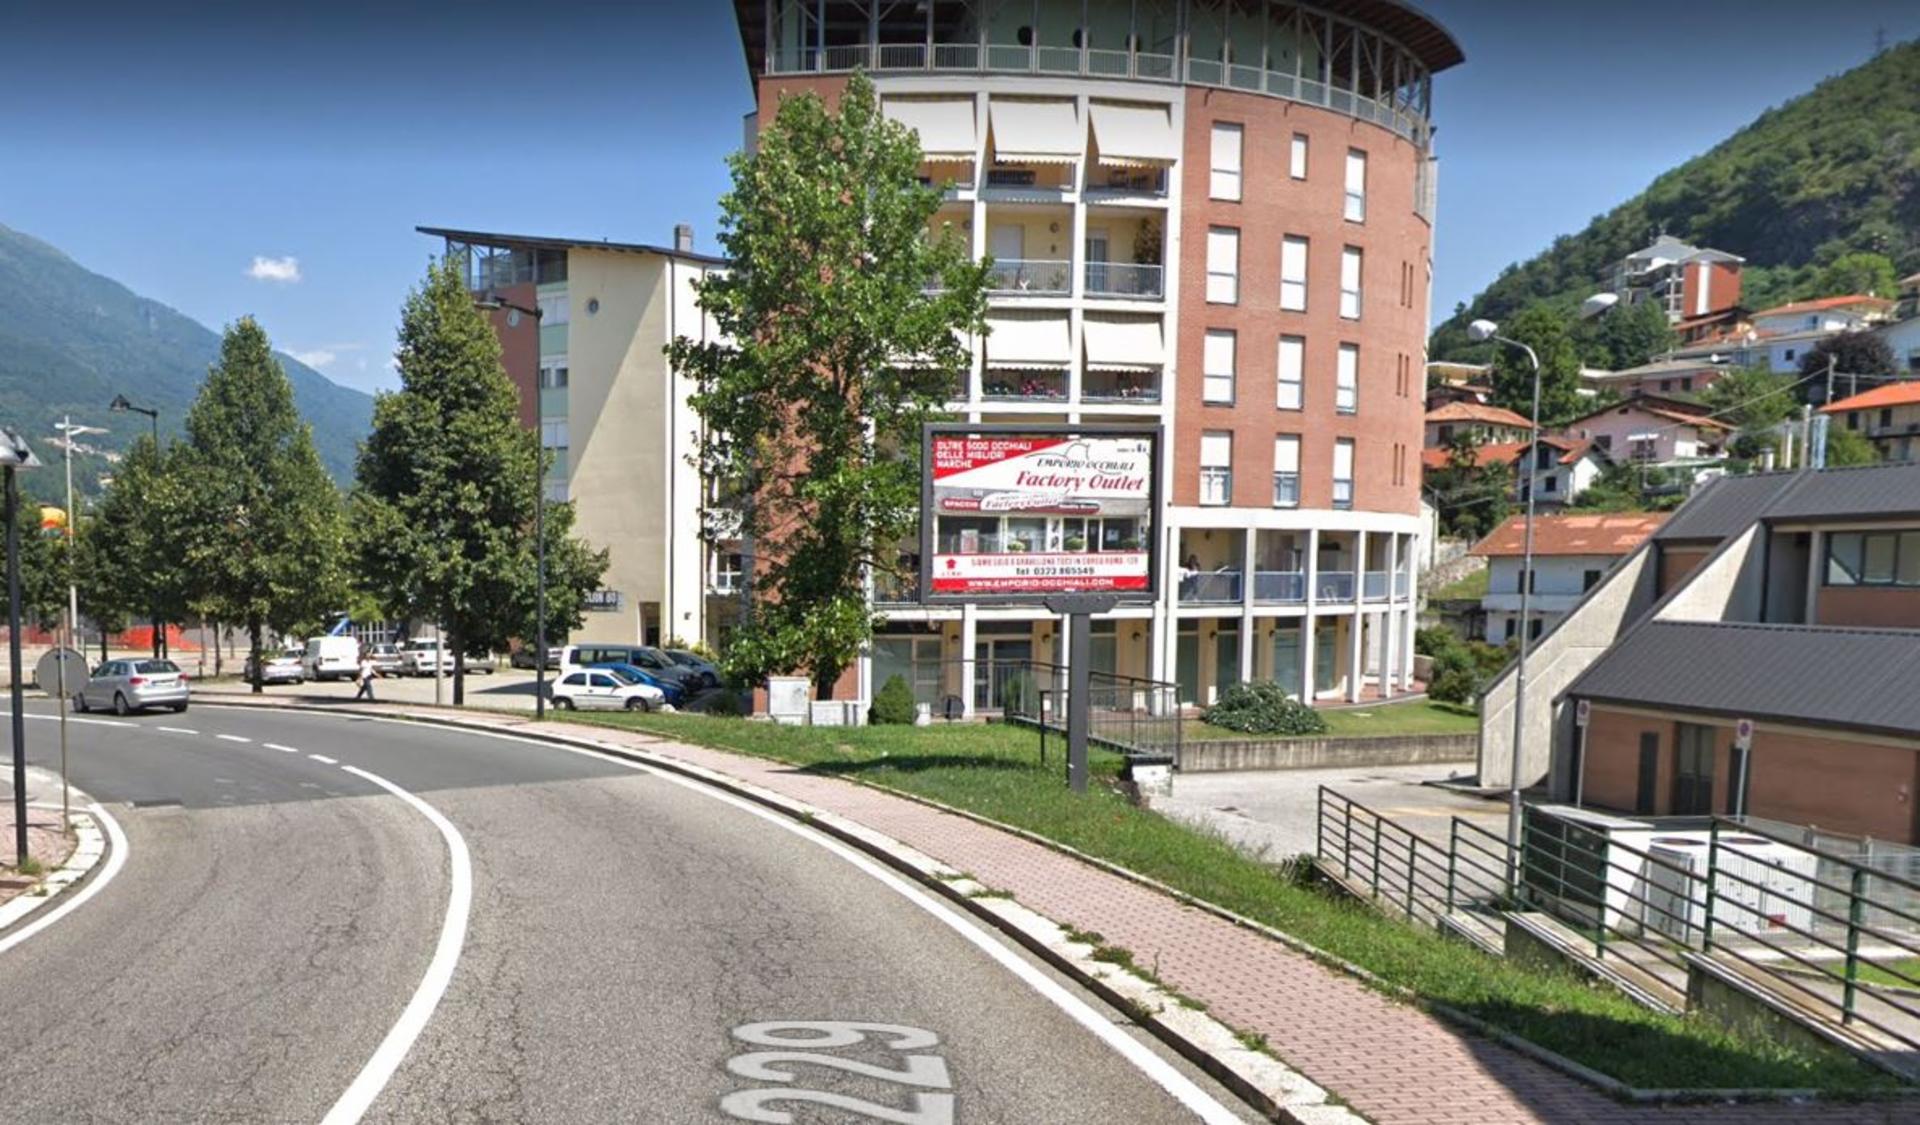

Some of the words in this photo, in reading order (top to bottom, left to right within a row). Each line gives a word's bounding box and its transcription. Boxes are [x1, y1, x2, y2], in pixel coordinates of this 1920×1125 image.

[937, 441, 963, 449] OLTRE
[991, 442, 1032, 450] OCCHIALI
[937, 450, 963, 459] DELLE
[967, 451, 1005, 459] MIGLIORI
[936, 460, 973, 468] MARCHE
[1037, 459, 1085, 470] EMPORIO
[1086, 460, 1135, 471] OCCHIALI
[1016, 470, 1086, 492] Factory
[1089, 473, 1144, 491] Outlet
[720, 1020, 954, 1125] 229
